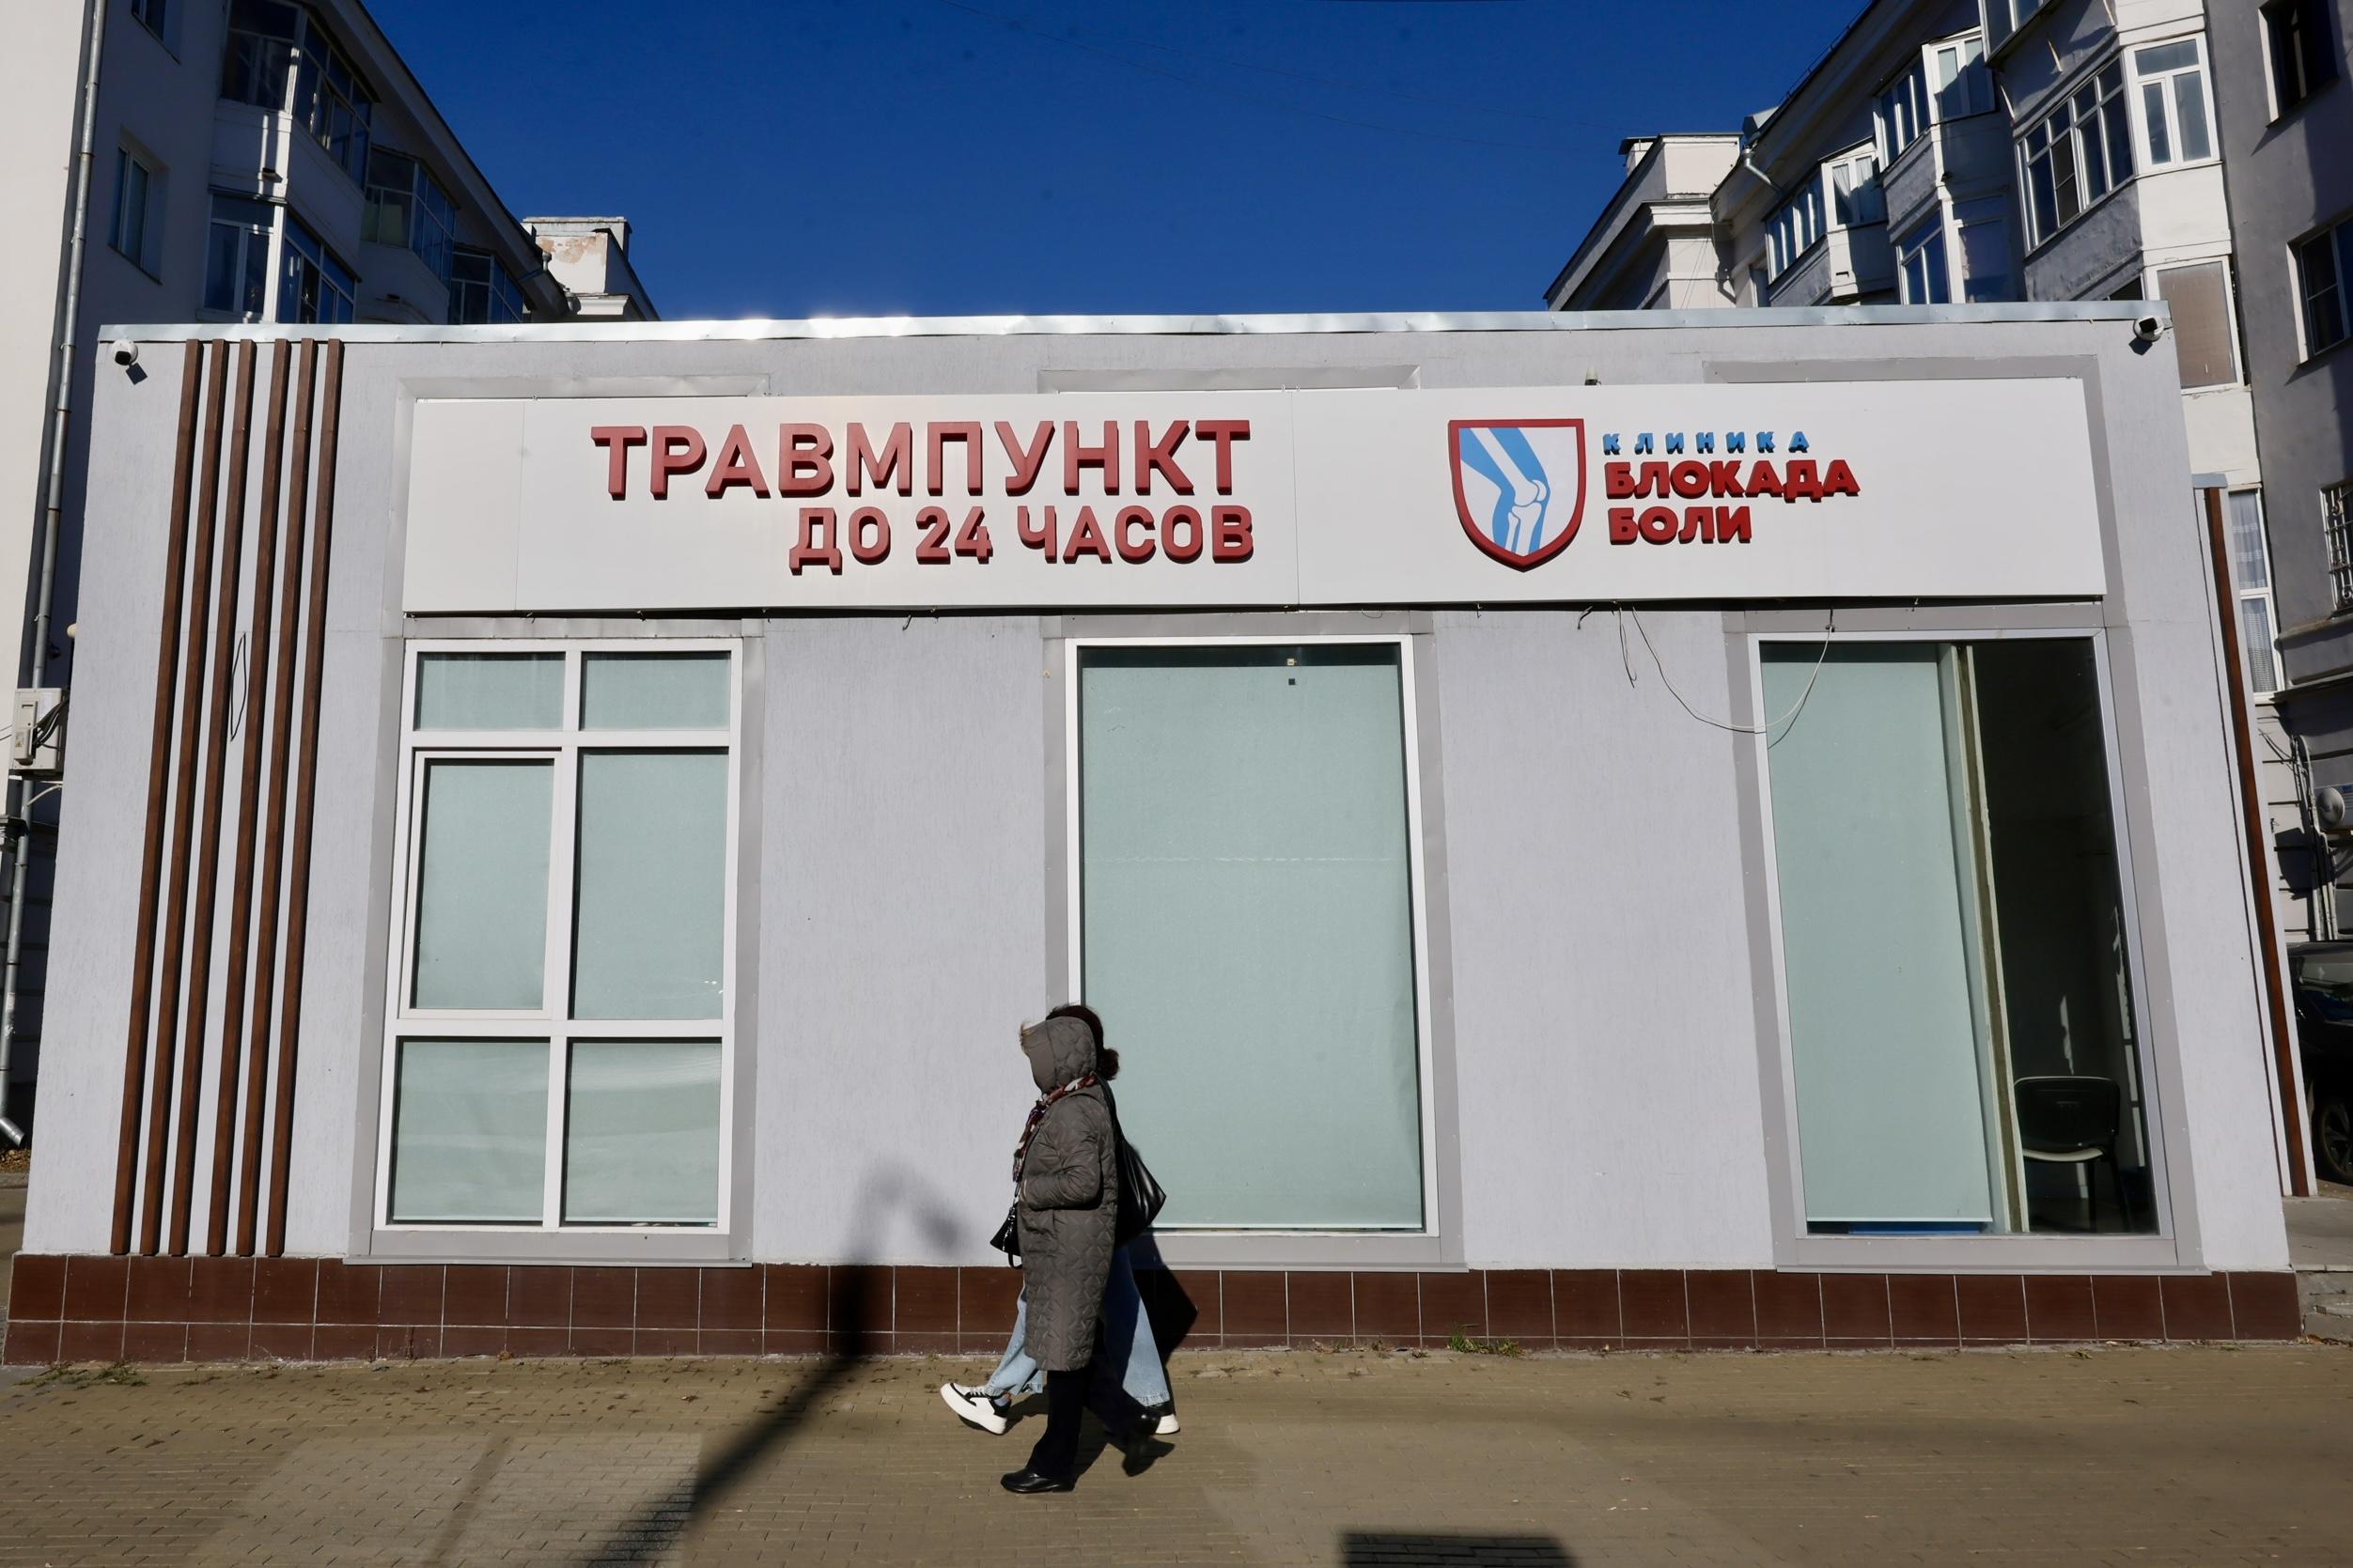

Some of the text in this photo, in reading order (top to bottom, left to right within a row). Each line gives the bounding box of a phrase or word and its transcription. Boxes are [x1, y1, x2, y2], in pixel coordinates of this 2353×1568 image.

[591, 420, 1251, 500] ТРАВМПУНКТ
[1603, 431, 1810, 455] КЛИНИКА
[1604, 458, 1861, 504] БЛОКАДА
[789, 505, 1254, 575] ДО 24 ЧАСОВ
[1608, 505, 1753, 546] БОЛИ
